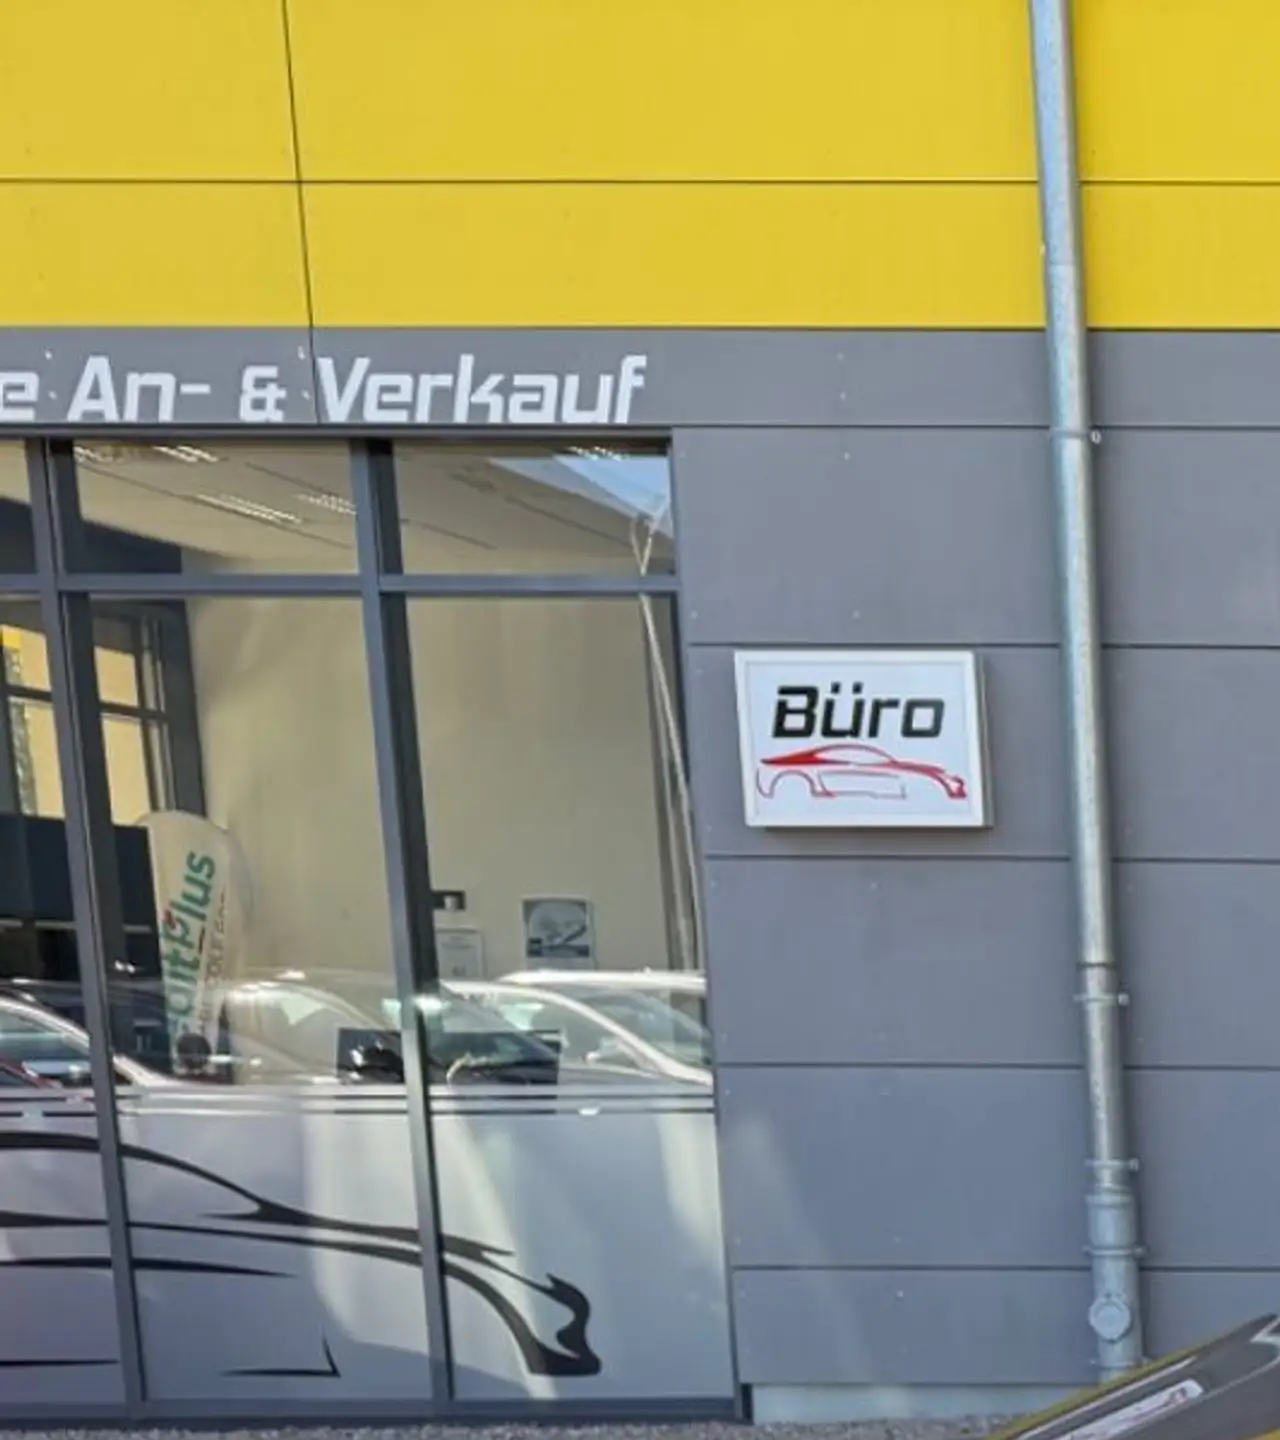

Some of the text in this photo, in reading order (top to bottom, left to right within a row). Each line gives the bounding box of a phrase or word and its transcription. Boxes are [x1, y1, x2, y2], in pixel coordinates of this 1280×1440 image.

[66, 355, 210, 423] An-
[238, 364, 287, 423] &
[317, 354, 647, 424] Verkauf
[771, 681, 945, 739] Büro
